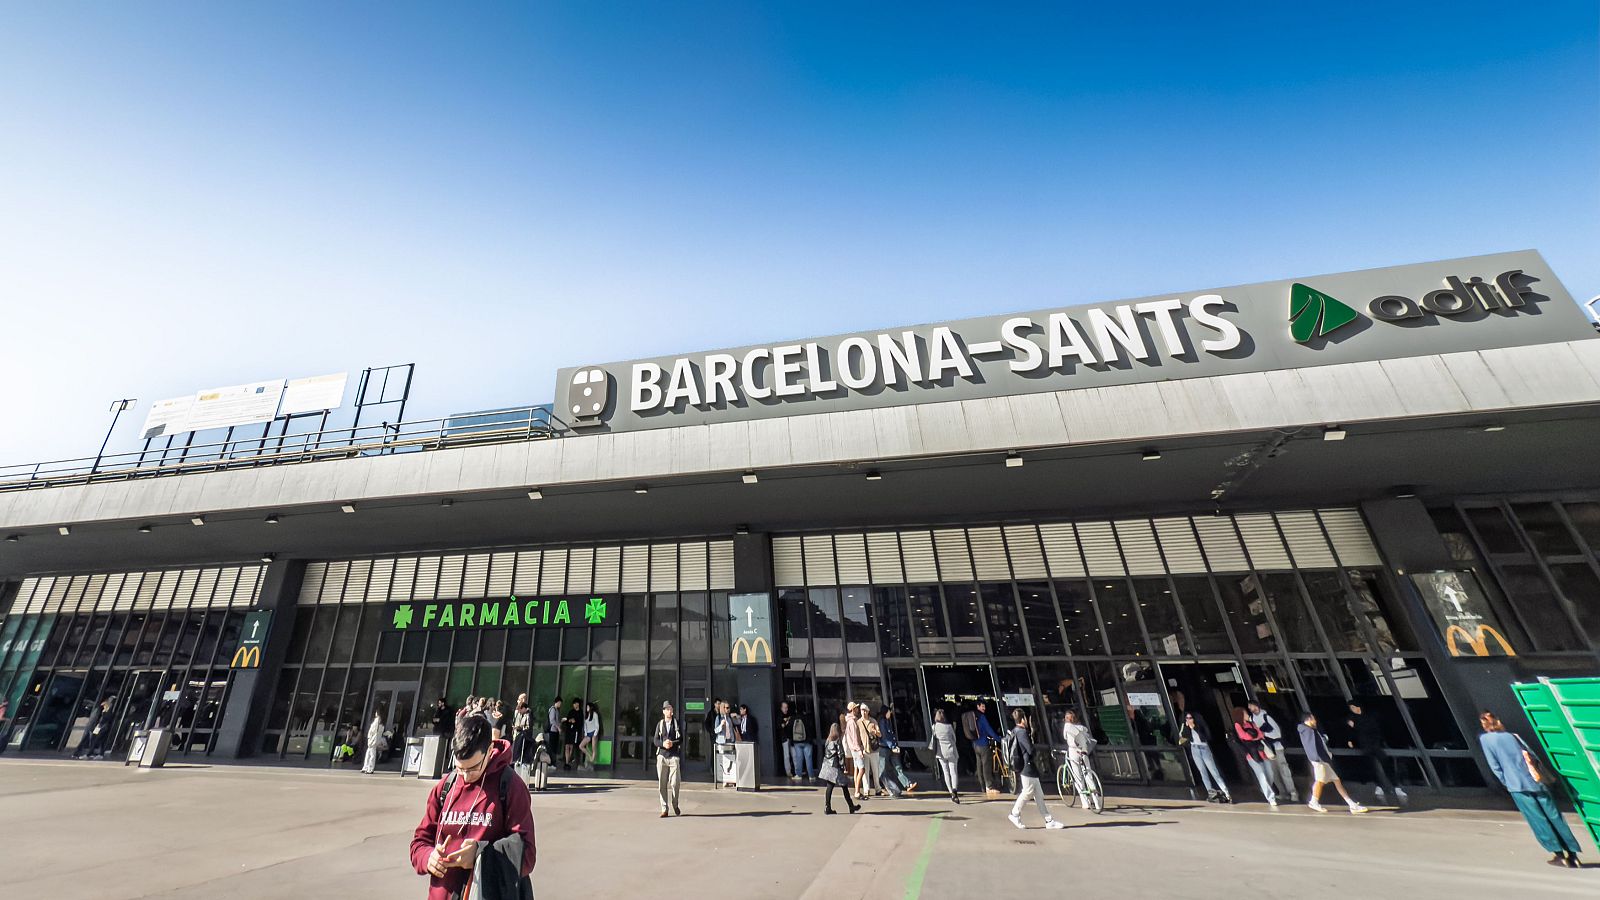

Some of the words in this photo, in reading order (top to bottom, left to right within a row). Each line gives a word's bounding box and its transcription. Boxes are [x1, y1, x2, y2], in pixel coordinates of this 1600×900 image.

[1366, 269, 1531, 321] adif
[422, 594, 572, 628] FARMÀCIA
[3, 639, 46, 652] CAGE
[441, 810, 493, 827] LL&EAR
